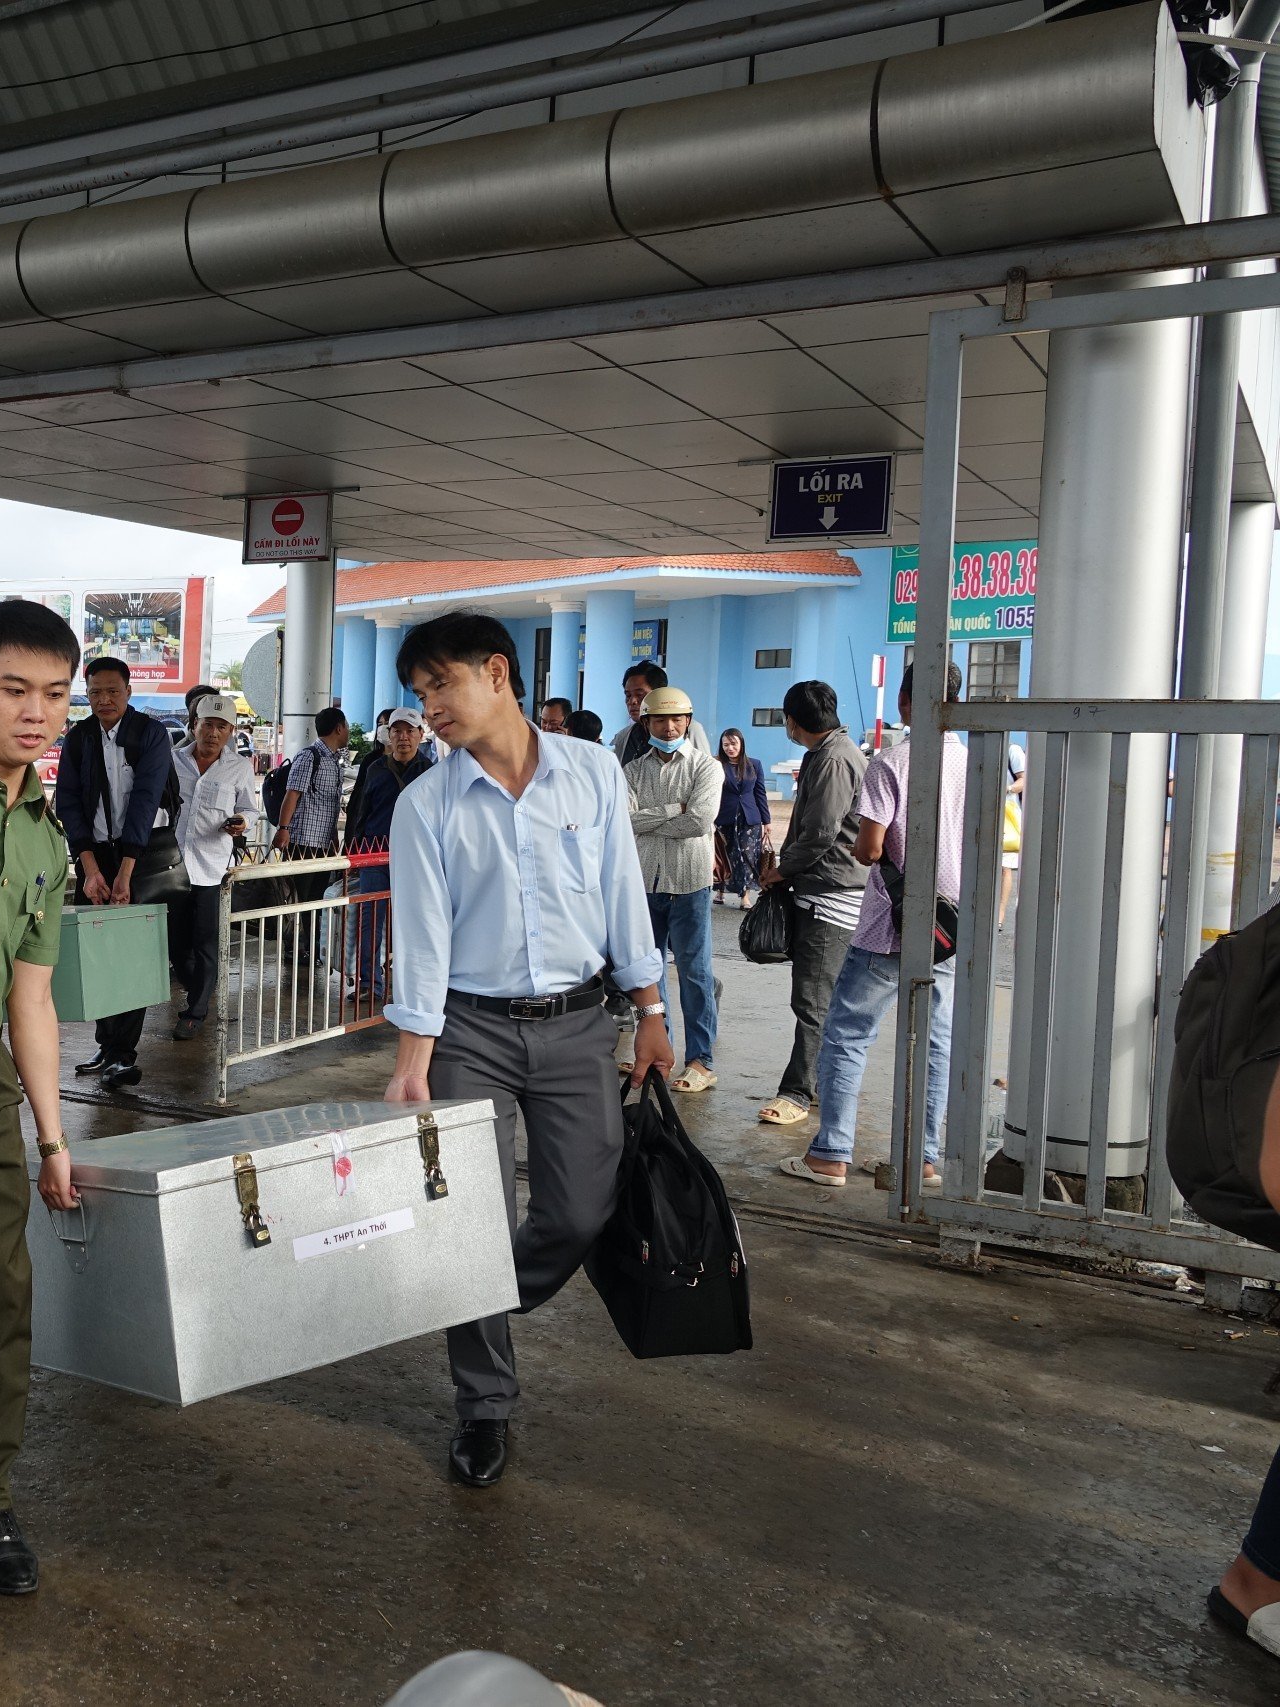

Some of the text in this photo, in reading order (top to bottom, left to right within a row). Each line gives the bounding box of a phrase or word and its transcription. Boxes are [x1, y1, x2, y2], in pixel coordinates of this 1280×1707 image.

[798, 468, 863, 492] LỐI RA
[817, 493, 843, 503] EXIT
[254, 535, 320, 549] CẤM ĐI LỐI NÀY
[964, 612, 992, 632] QUỐC
[323, 1221, 387, 1245] 4. THPT An Thới
